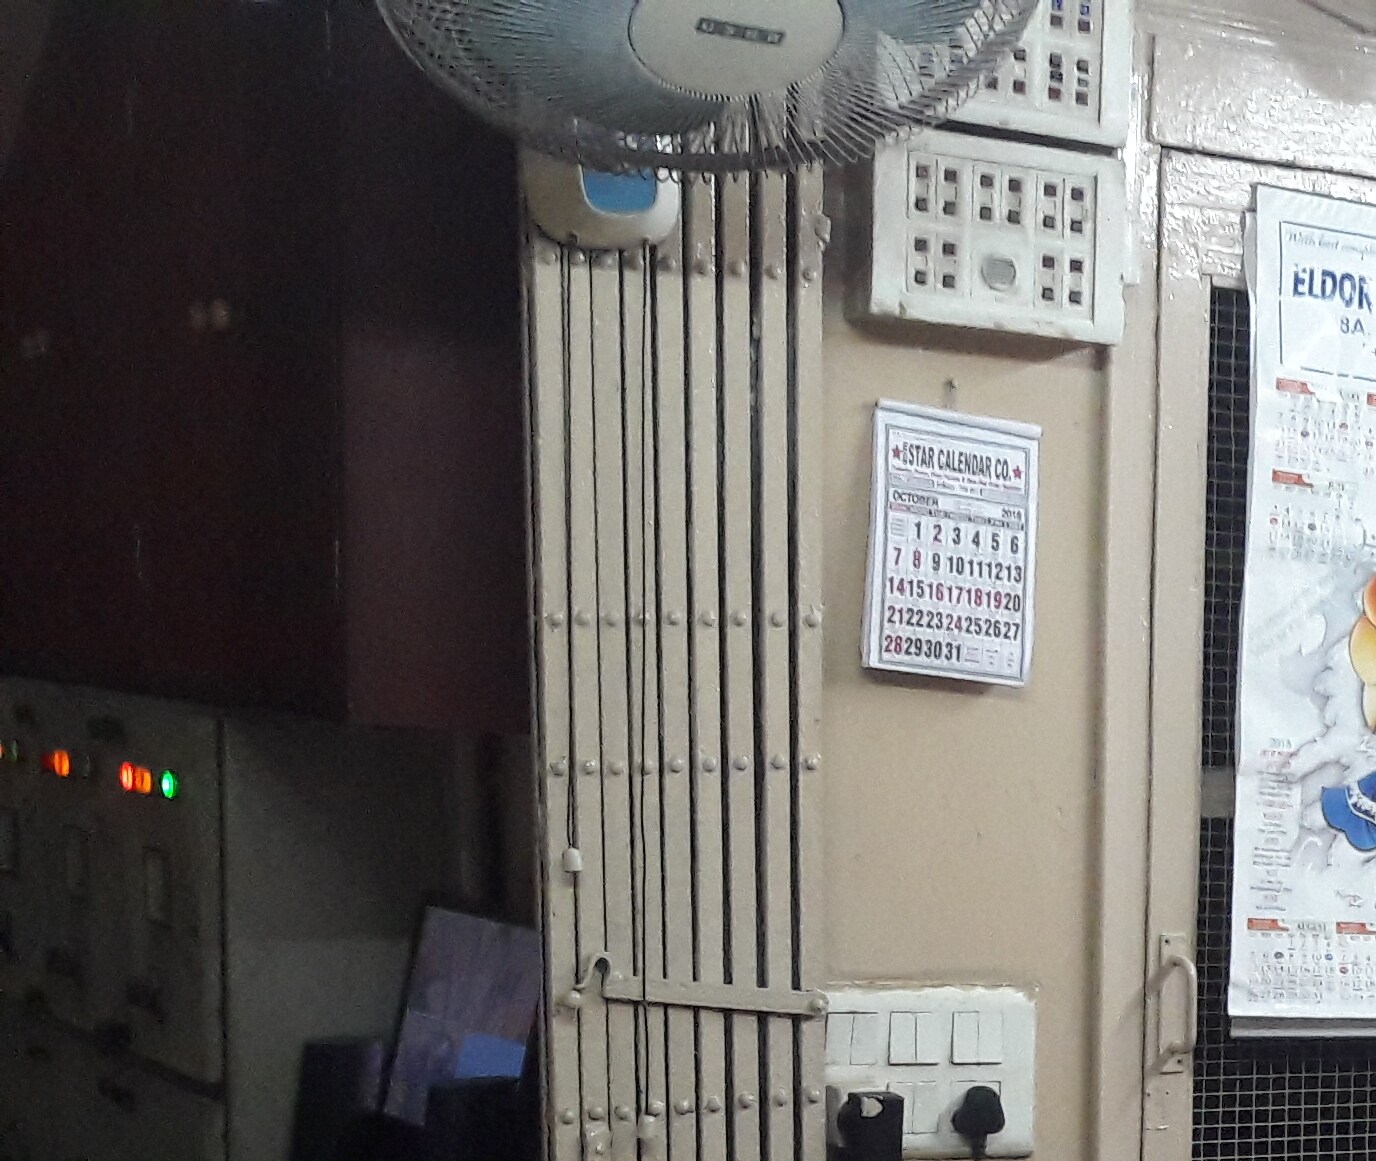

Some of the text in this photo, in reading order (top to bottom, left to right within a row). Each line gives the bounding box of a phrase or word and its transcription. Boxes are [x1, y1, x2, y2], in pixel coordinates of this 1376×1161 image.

[938, 449, 991, 481] CALENDAR
[994, 457, 1011, 482] CO.
[914, 521, 1019, 554] 1 2 3 4 5 6
[893, 547, 1022, 583] 7 8 9 10 11 12 13
[888, 576, 1021, 612] 14 15 16 17 18 19 20
[887, 605, 1020, 641] 21 22 23 24 25 26 27
[884, 635, 962, 662] 28 29 30 31
